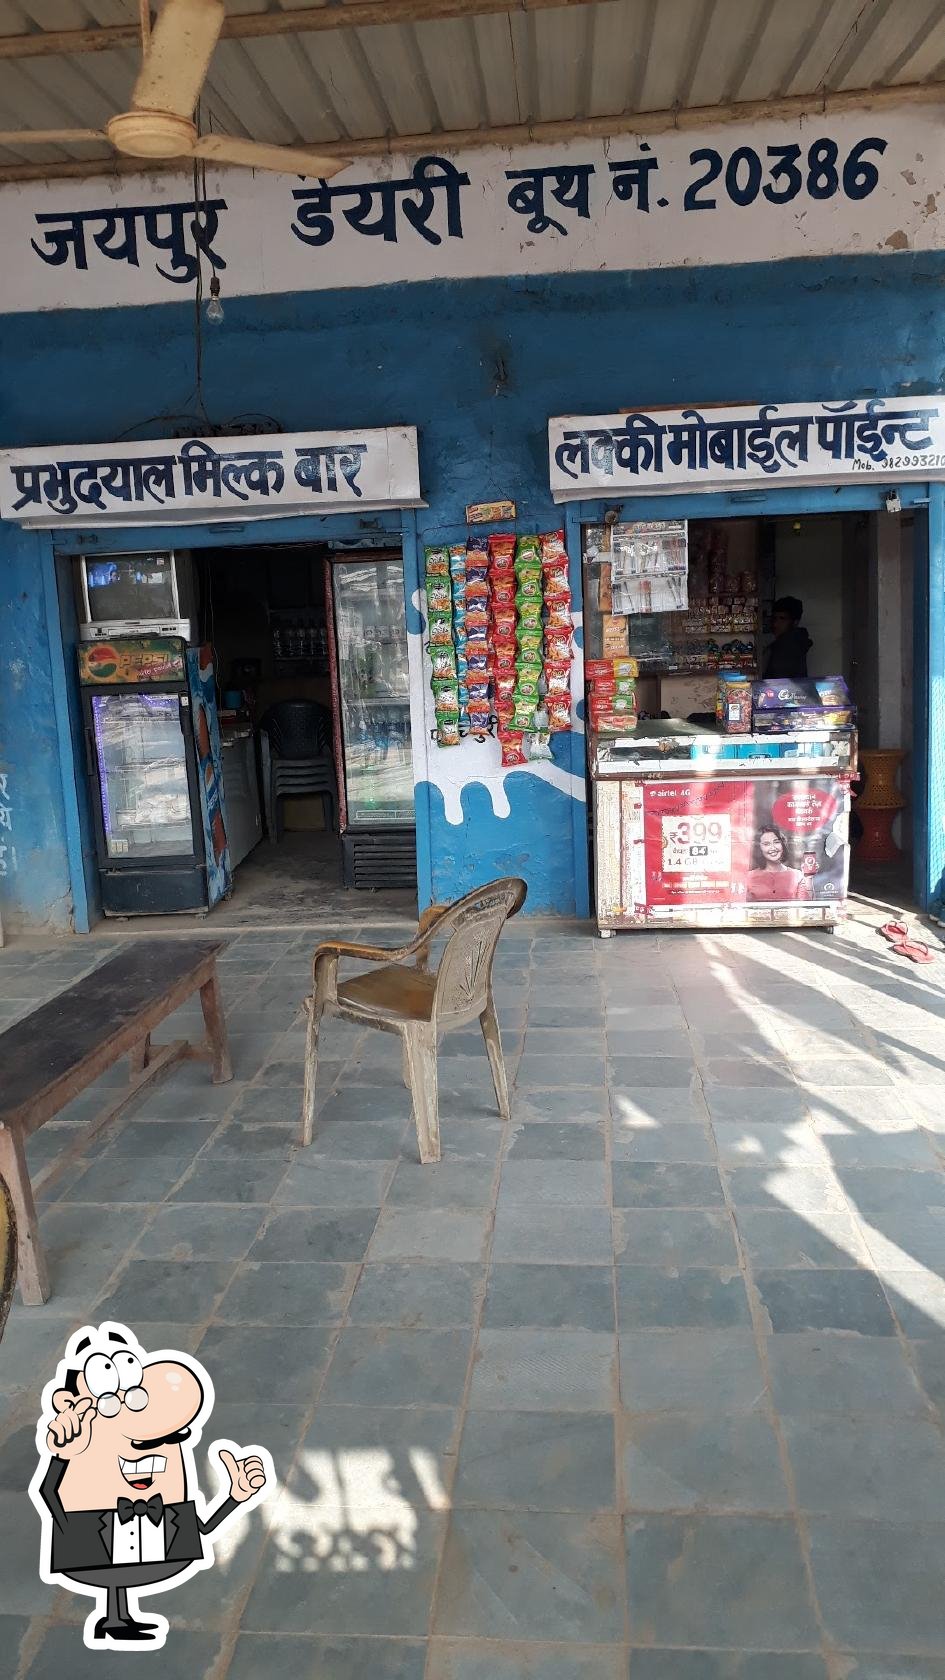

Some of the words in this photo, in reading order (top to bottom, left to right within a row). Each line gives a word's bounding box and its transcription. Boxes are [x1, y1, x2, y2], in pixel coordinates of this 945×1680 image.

[30, 198, 228, 283] जयपुर
[505, 163, 595, 236] बूथ
[608, 143, 668, 212] नं.
[683, 137, 888, 212] 20386
[667, 406, 815, 473] मोबाईल
[816, 398, 938, 462] पॉईन्ट
[852, 458, 875, 471] Mob.
[10, 456, 178, 514] प्रभुदयाल
[179, 440, 286, 501] मिल्क
[294, 444, 368, 498] बार
[657, 789, 677, 797] airtel
[680, 788, 691, 797] 4G
